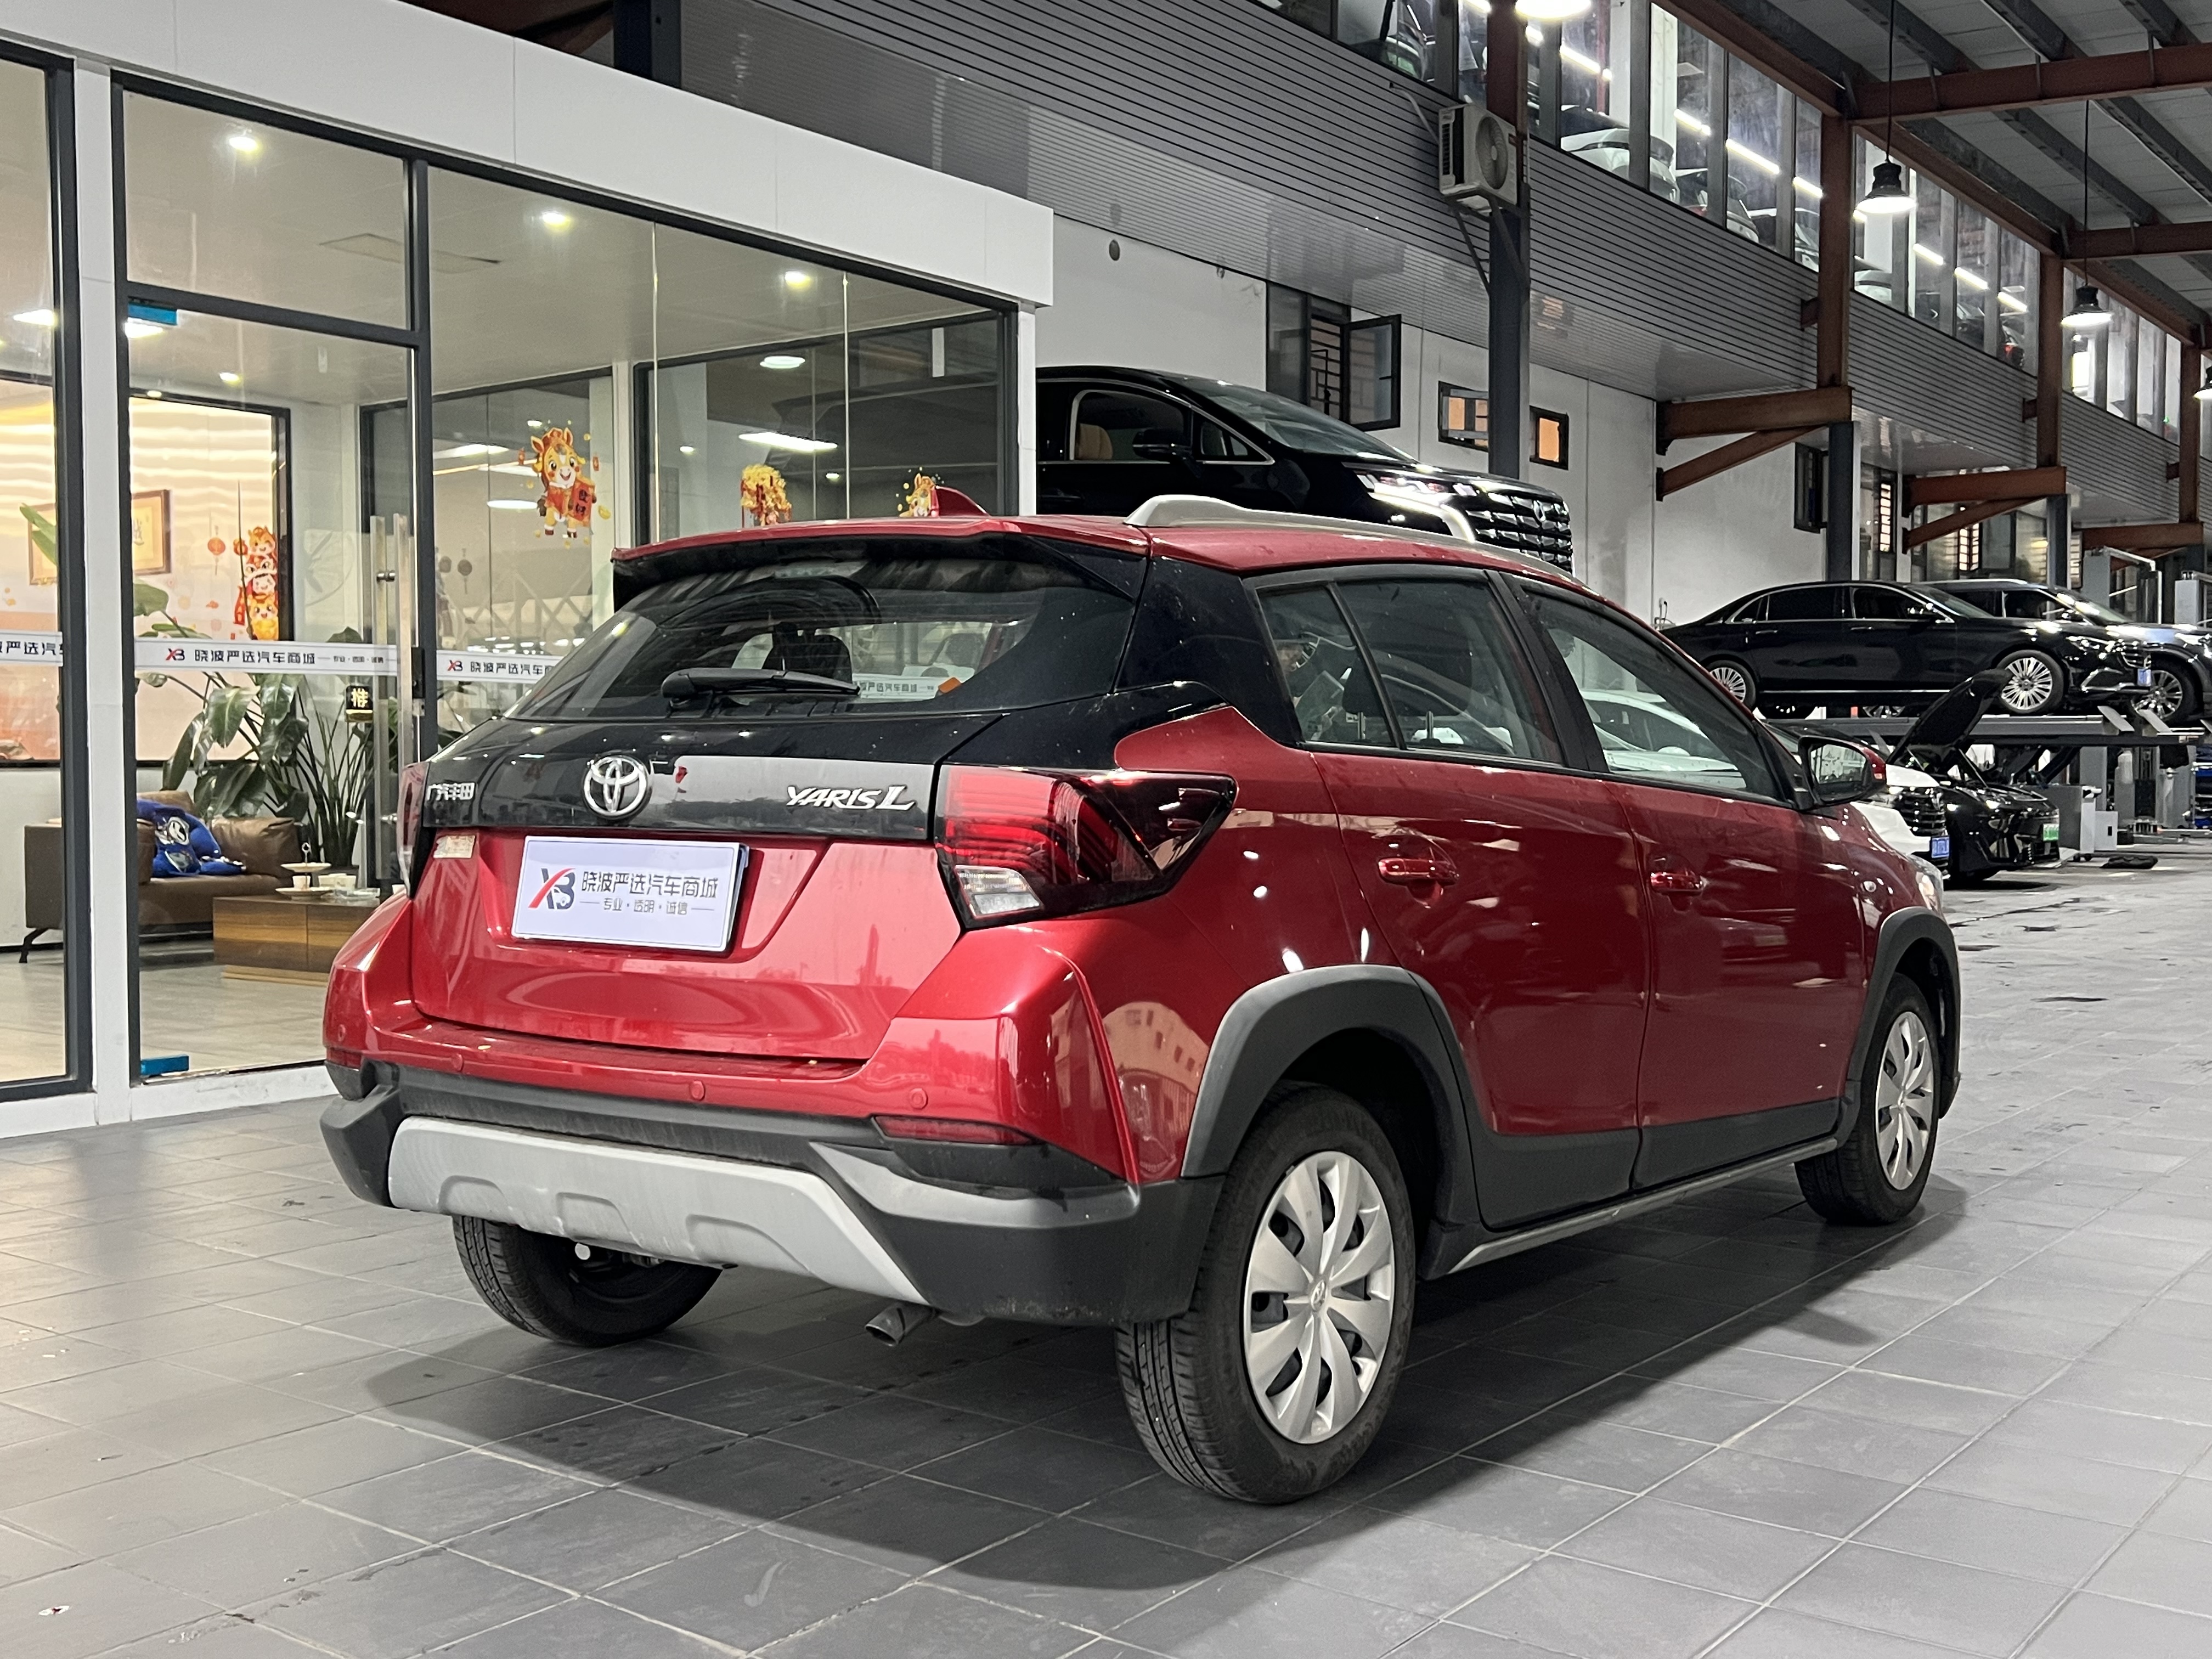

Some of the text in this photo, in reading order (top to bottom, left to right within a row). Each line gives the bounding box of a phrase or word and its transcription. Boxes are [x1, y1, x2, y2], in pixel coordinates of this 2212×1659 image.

[0, 640, 63, 656] 严选汽
[194, 649, 315, 664] 晓波严选汽车商城
[351, 687, 369, 708] 推
[427, 782, 475, 800] 广汽丰田
[786, 785, 915, 811] YARIS L
[582, 871, 719, 899] 晓波严选汽车商城
